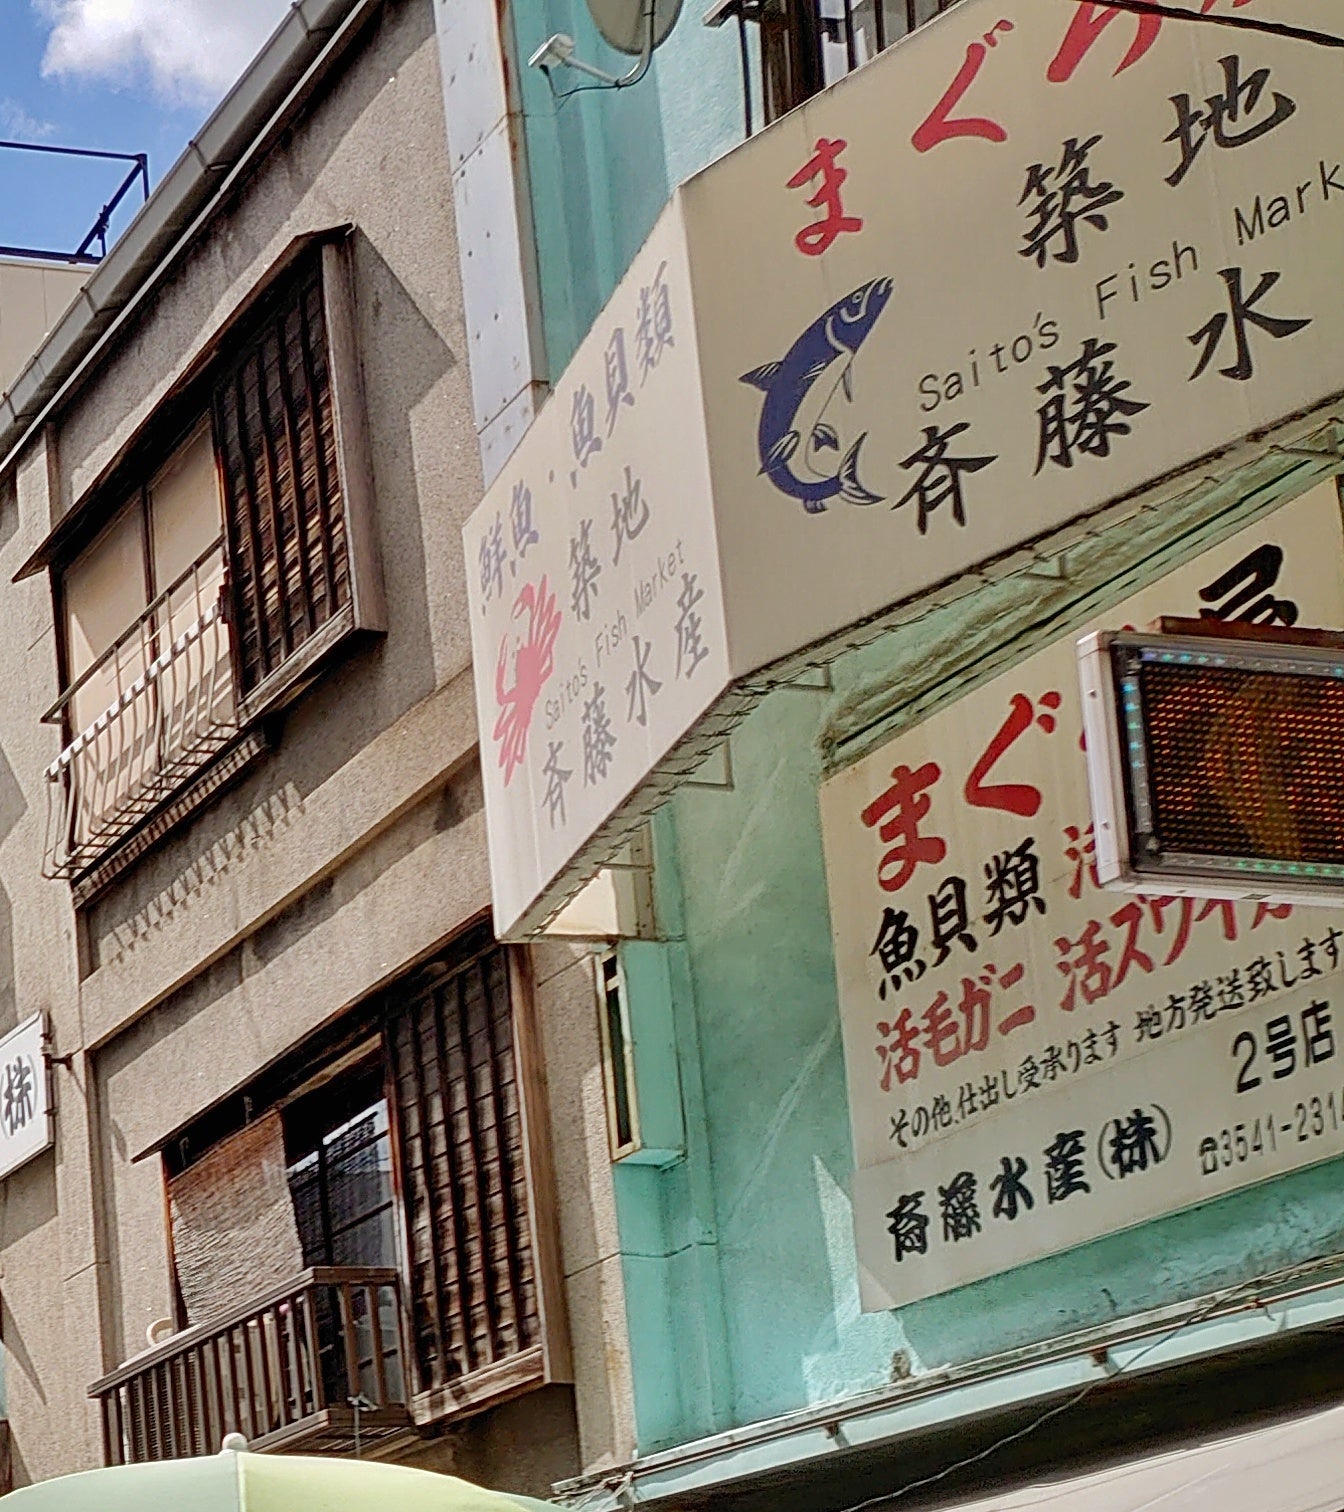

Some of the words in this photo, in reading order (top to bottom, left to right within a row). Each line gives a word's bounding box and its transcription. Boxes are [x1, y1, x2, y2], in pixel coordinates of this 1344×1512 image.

[1016, 54, 1297, 269] 築地
[918, 310, 1062, 413] Saito's
[1094, 239, 1199, 320] Fish
[567, 465, 650, 624] 築地
[544, 656, 586, 731] Saito's
[594, 607, 628, 668] Fish
[633, 536, 687, 616] Market
[861, 688, 1087, 895] まぐ
[870, 836, 1047, 1000] 魚貝類
[874, 962, 1036, 1093] 活毛ガニ
[1231, 1001, 1336, 1094] 2号店
[1219, 1084, 1344, 1168] 3541-231
